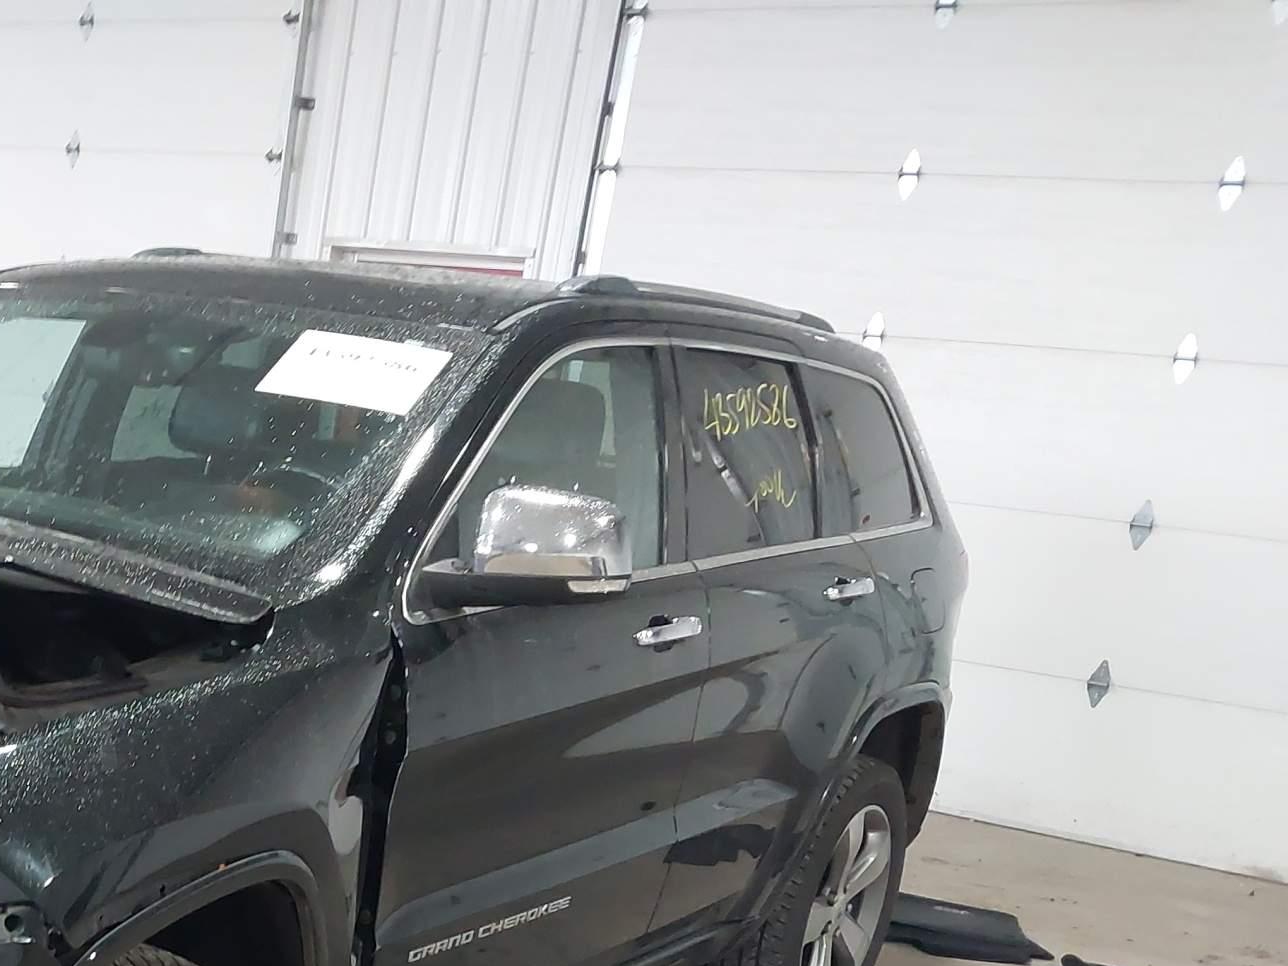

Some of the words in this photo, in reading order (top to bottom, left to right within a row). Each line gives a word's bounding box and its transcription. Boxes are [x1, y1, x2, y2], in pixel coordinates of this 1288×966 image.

[703, 383, 798, 441] 43592586
[408, 930, 475, 963] GRAND
[478, 896, 572, 938] CHEROKEE
